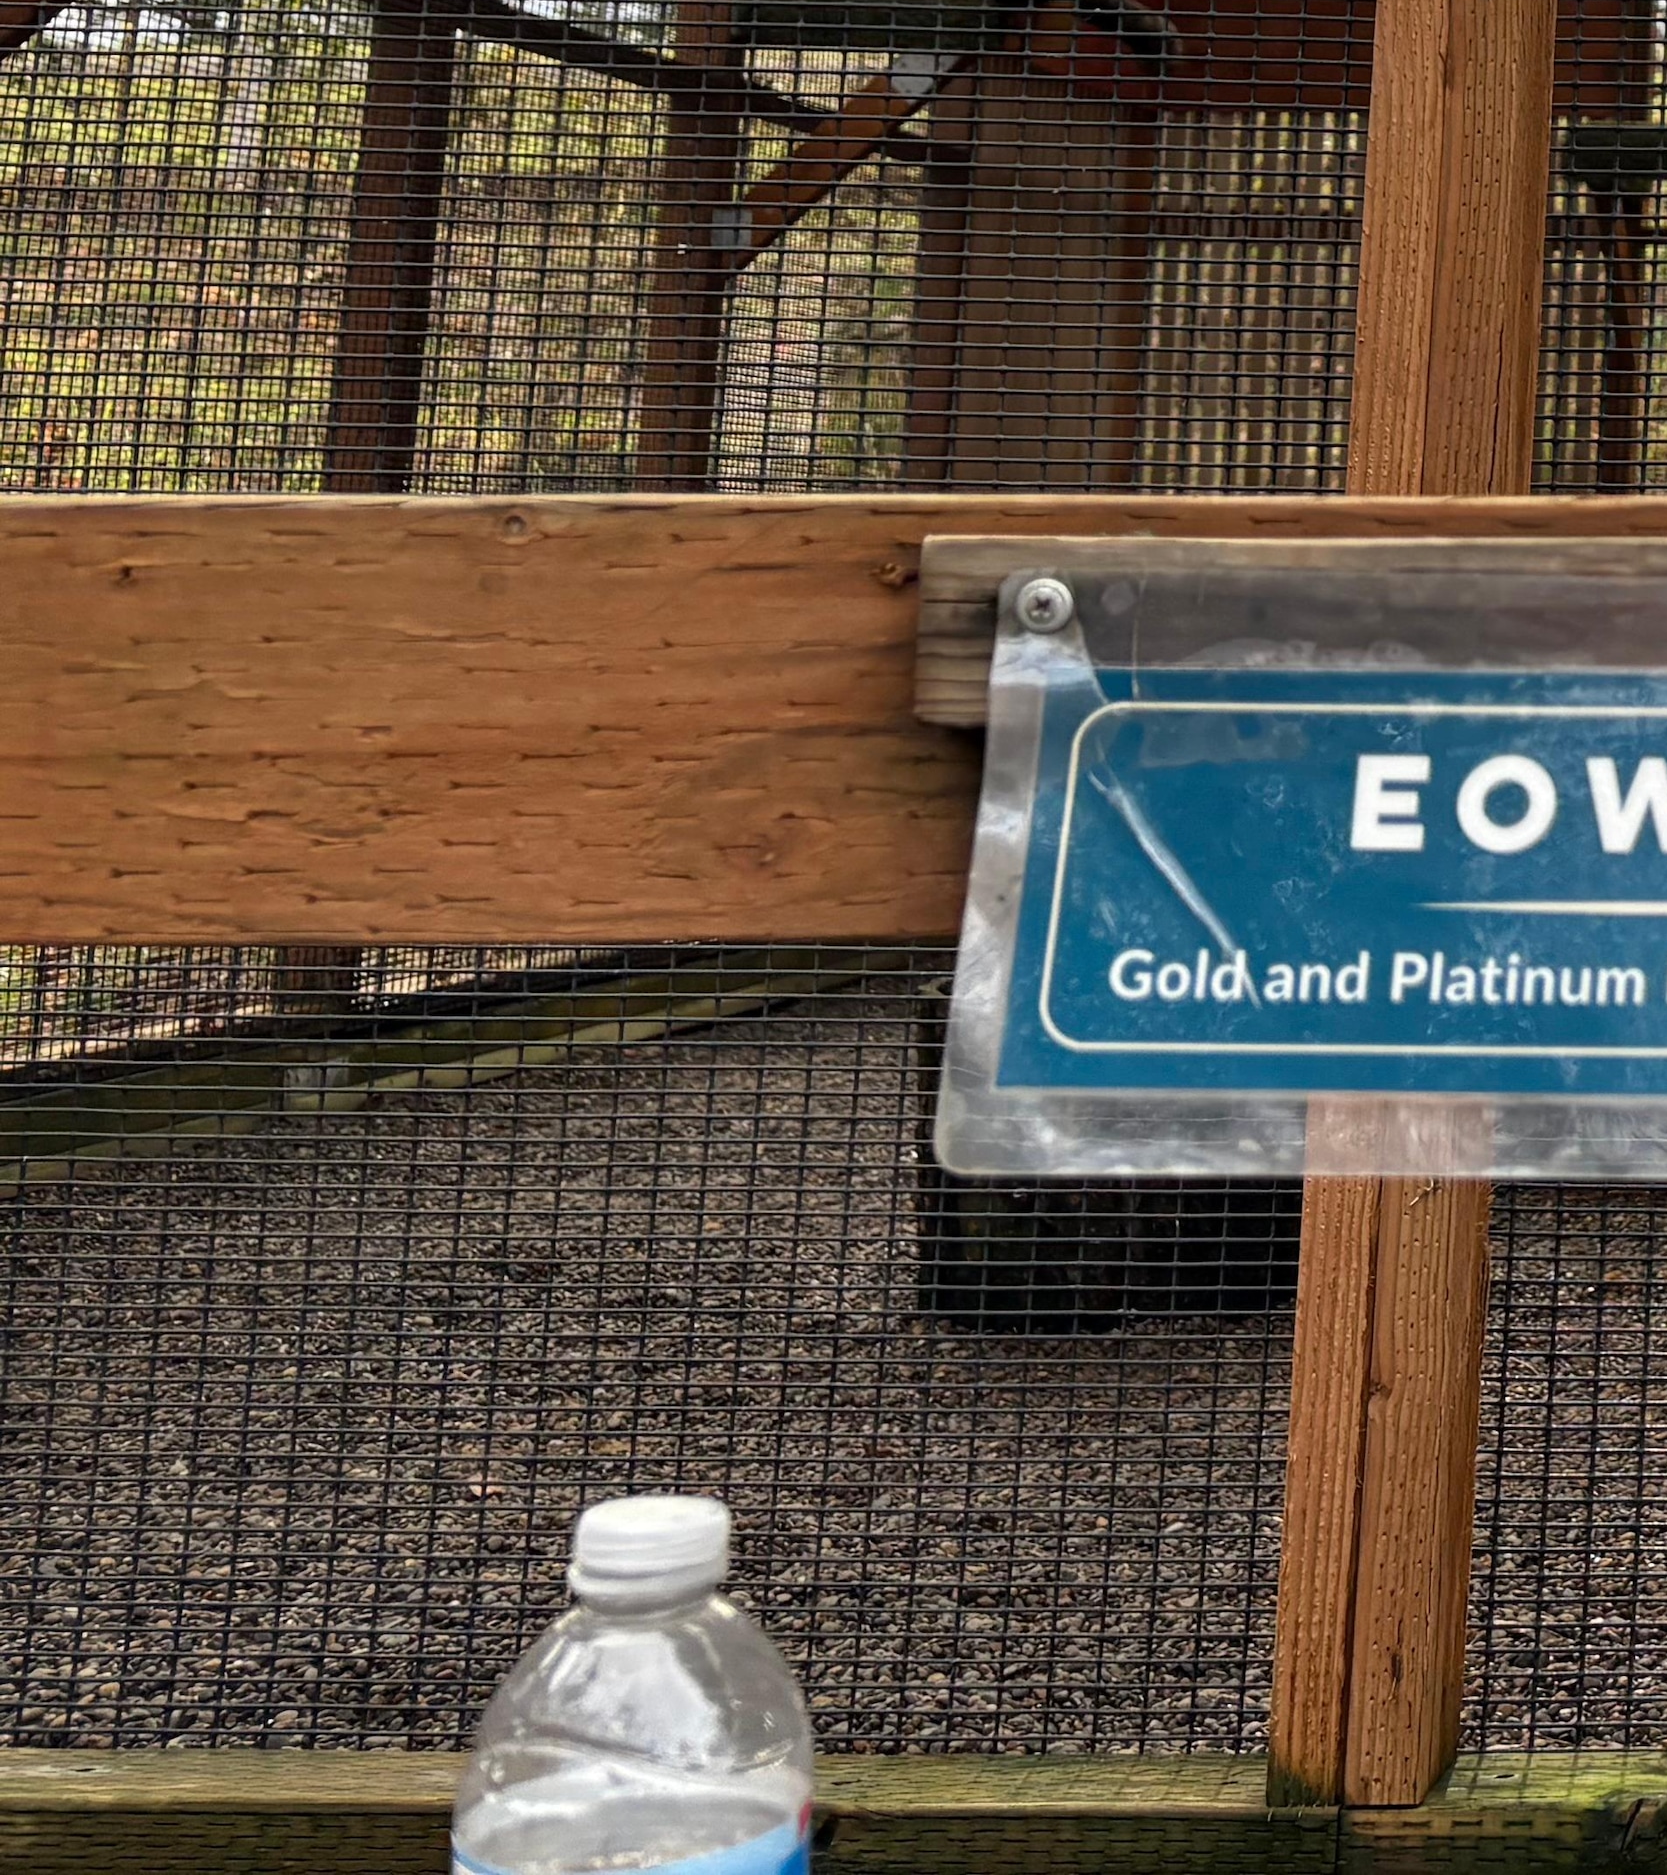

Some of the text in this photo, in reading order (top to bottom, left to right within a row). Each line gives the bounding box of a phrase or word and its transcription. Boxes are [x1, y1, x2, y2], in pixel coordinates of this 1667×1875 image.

[1108, 947, 1247, 1003] Gold
[1262, 948, 1371, 1004] and
[1391, 950, 1646, 1007] Platinum
